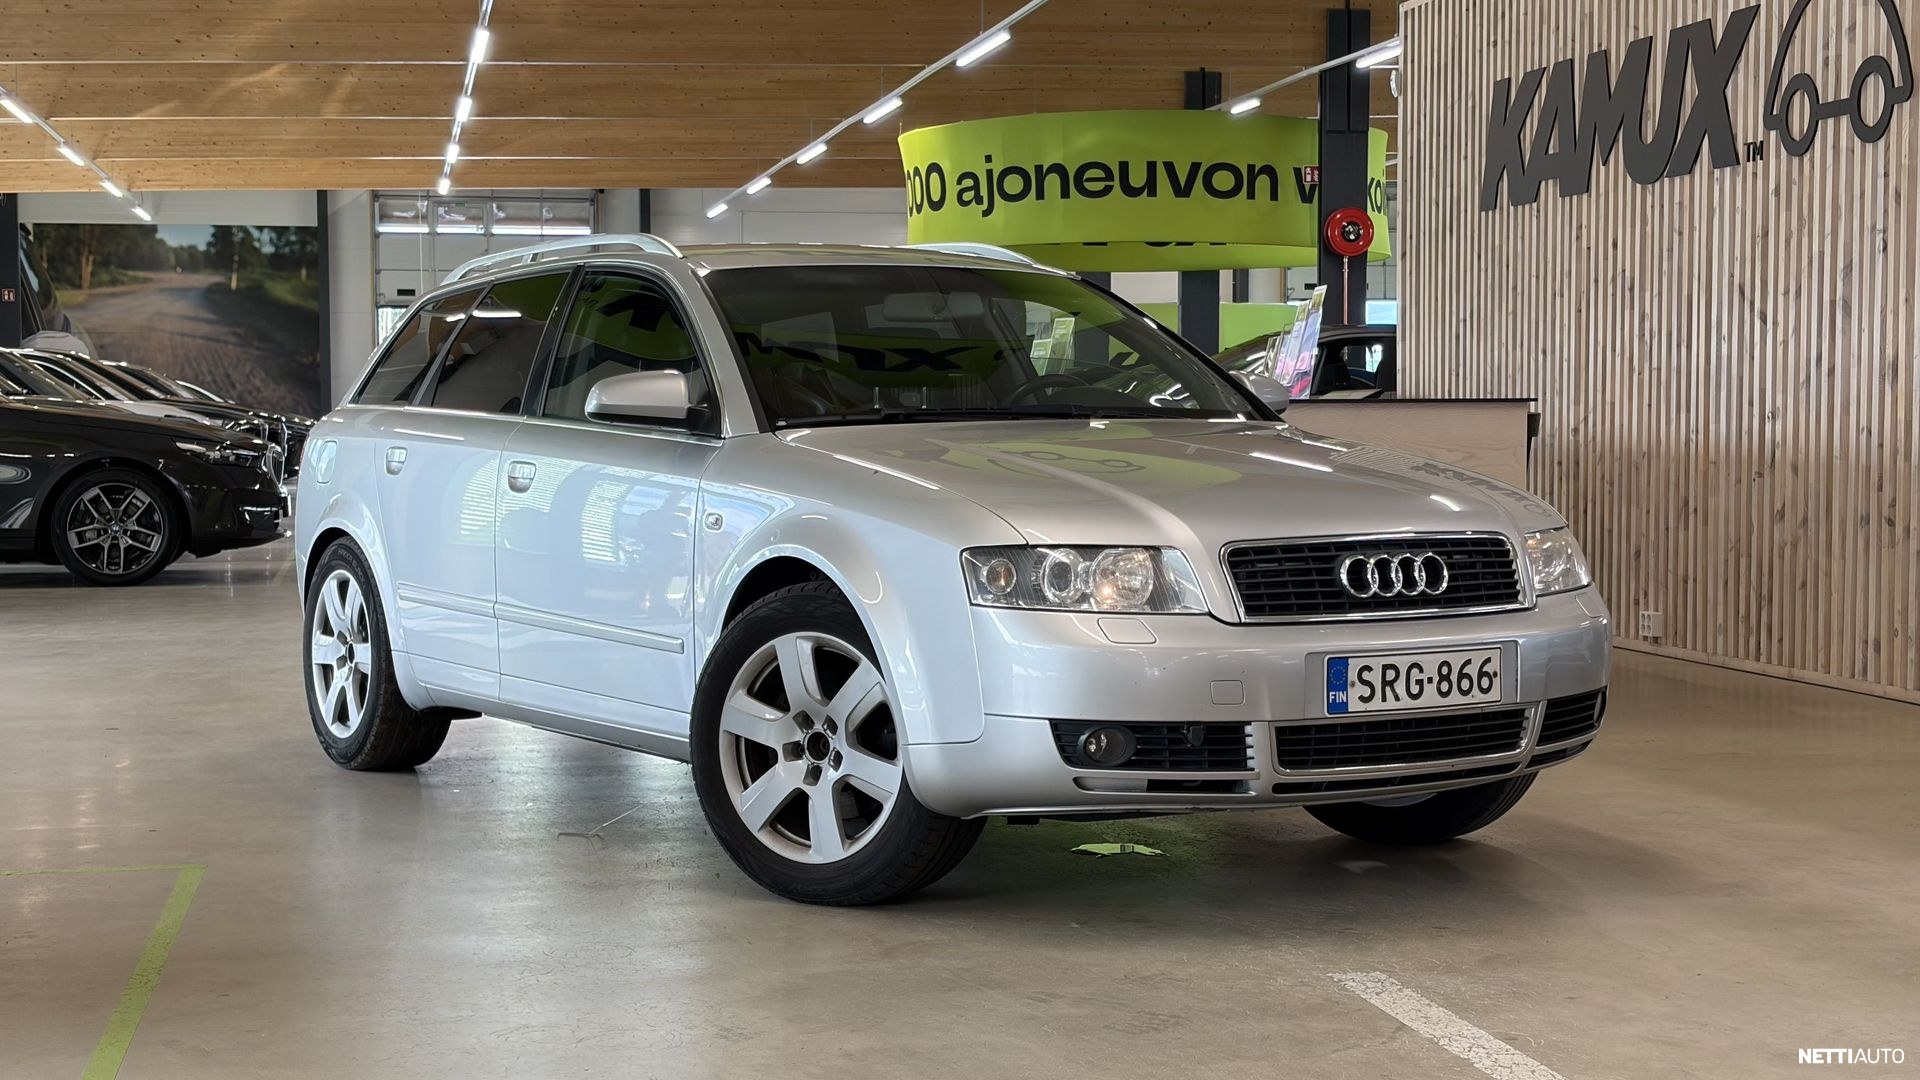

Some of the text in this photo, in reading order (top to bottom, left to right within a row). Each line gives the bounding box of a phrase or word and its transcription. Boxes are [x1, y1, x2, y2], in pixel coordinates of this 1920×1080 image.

[1480, 4, 1764, 212] KAMUX TM
[956, 154, 1279, 217] ajoneuvon
[1329, 691, 1347, 703] FIN
[1357, 657, 1494, 704] SRG-866
